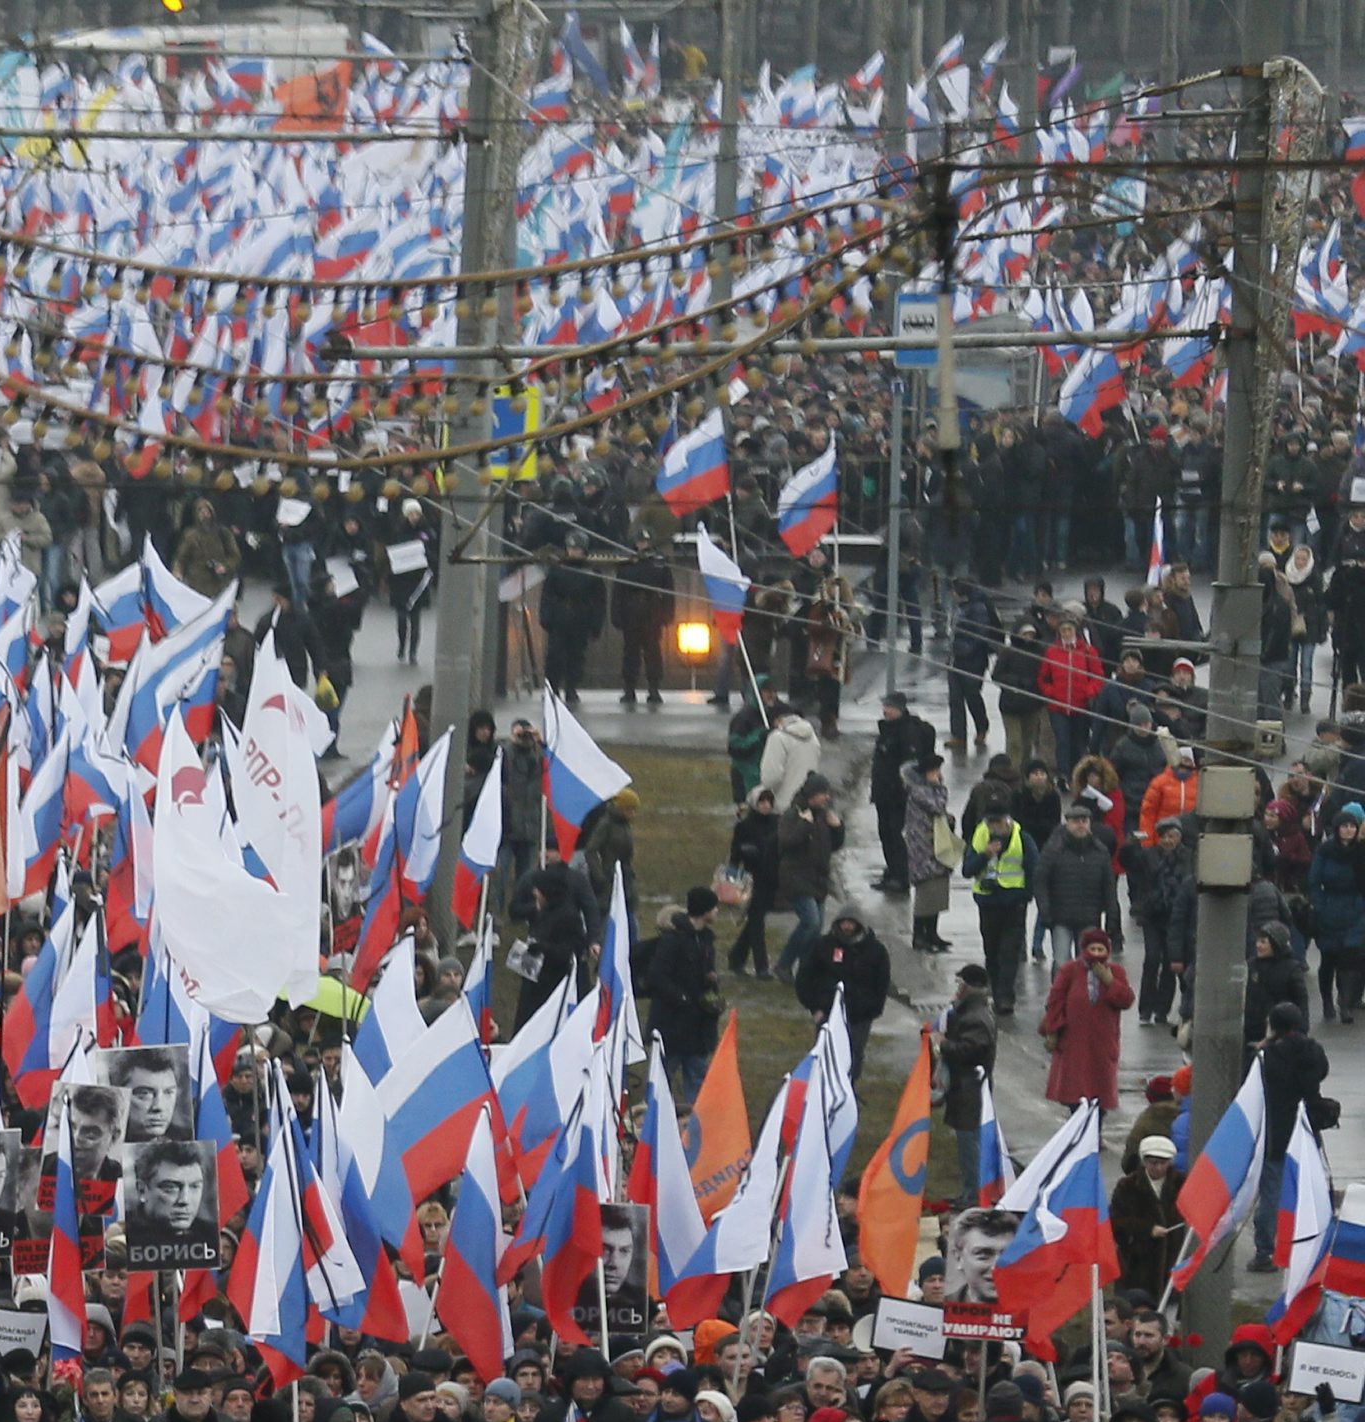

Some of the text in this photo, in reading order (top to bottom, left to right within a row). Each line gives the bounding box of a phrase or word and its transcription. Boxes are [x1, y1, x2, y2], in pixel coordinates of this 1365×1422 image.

[130, 1242, 216, 1262] БОРИСЬ
[992, 1313, 1012, 1325] НЕ
[943, 1323, 1024, 1340] УМИРАЮТ
[1309, 1365, 1321, 1373] НЕ
[1323, 1367, 1358, 1380] БОЮСЬ
